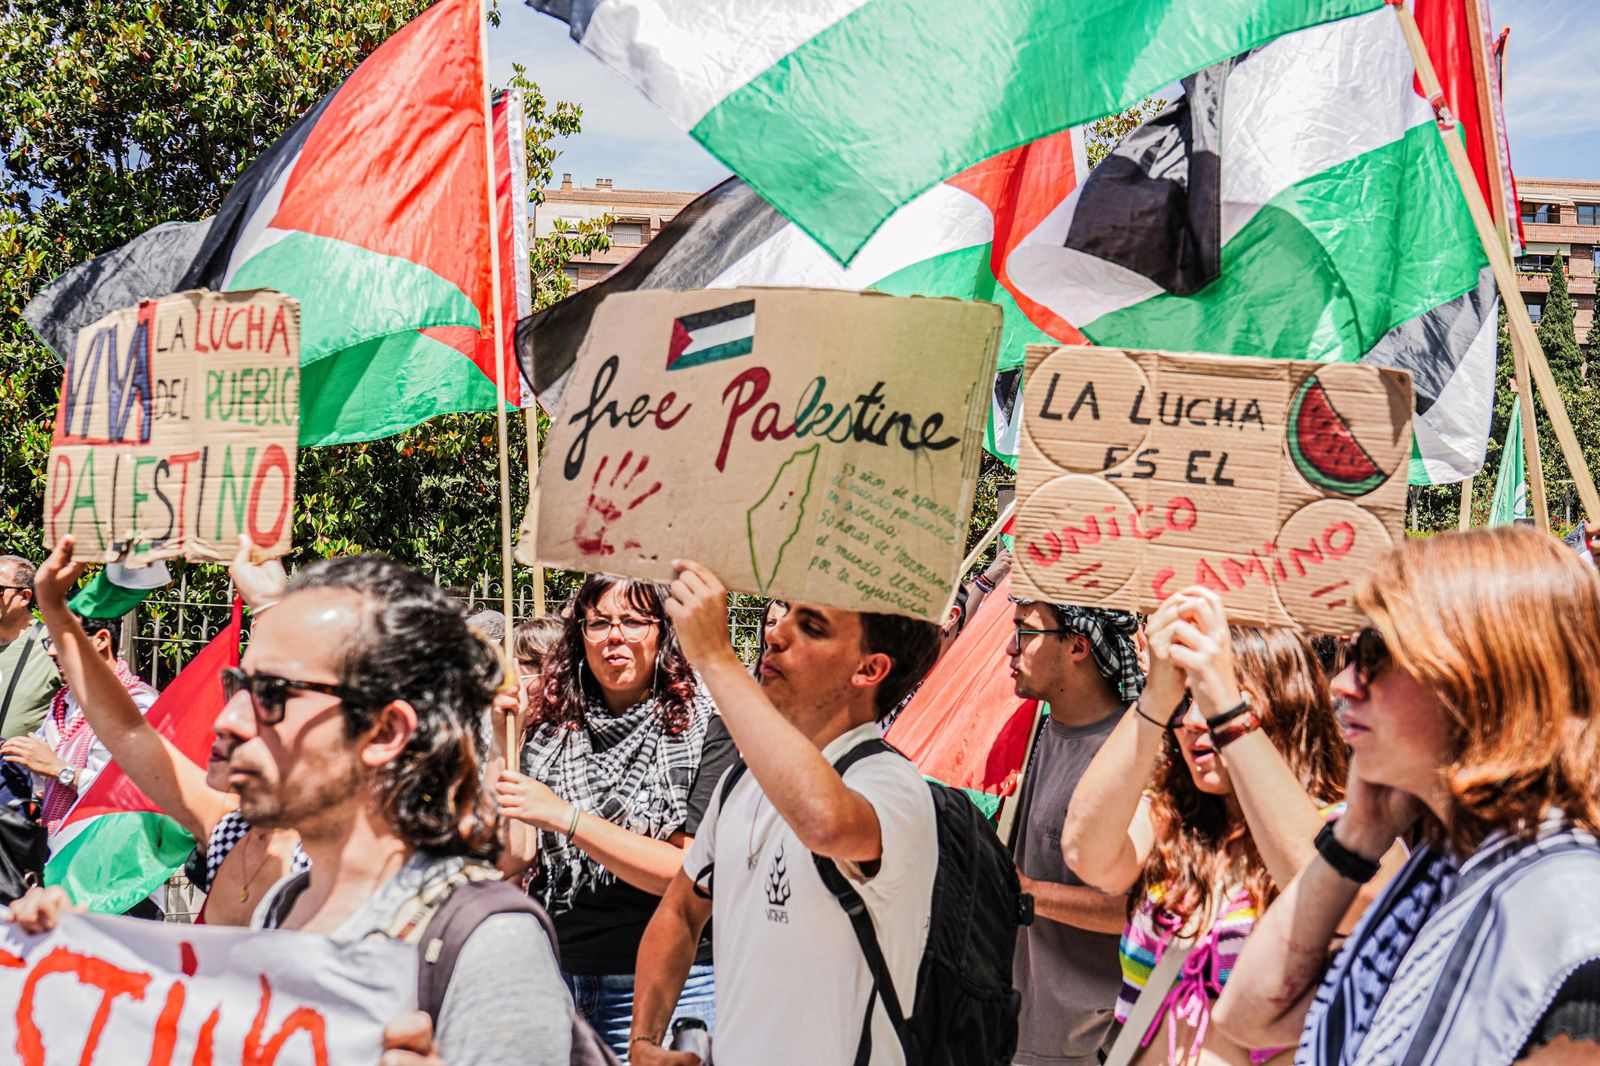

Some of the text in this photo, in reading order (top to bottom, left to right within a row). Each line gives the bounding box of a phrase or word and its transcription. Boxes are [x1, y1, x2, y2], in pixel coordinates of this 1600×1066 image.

[63, 303, 291, 443] VIVA LA LUCHA
[154, 366, 298, 427] DEL PUEBLO
[1038, 372, 1266, 432] LA LUCHA
[714, 366, 961, 473] Palestine
[847, 480, 893, 511] mundo
[859, 471, 886, 490] años
[892, 485, 910, 500] de
[1103, 445, 1235, 488] ES EL
[50, 442, 292, 555] PALESTINO
[835, 516, 871, 545] horas
[872, 539, 891, 556] de
[808, 555, 930, 617] por la injusticia
[816, 534, 933, 603] el mundo llora
